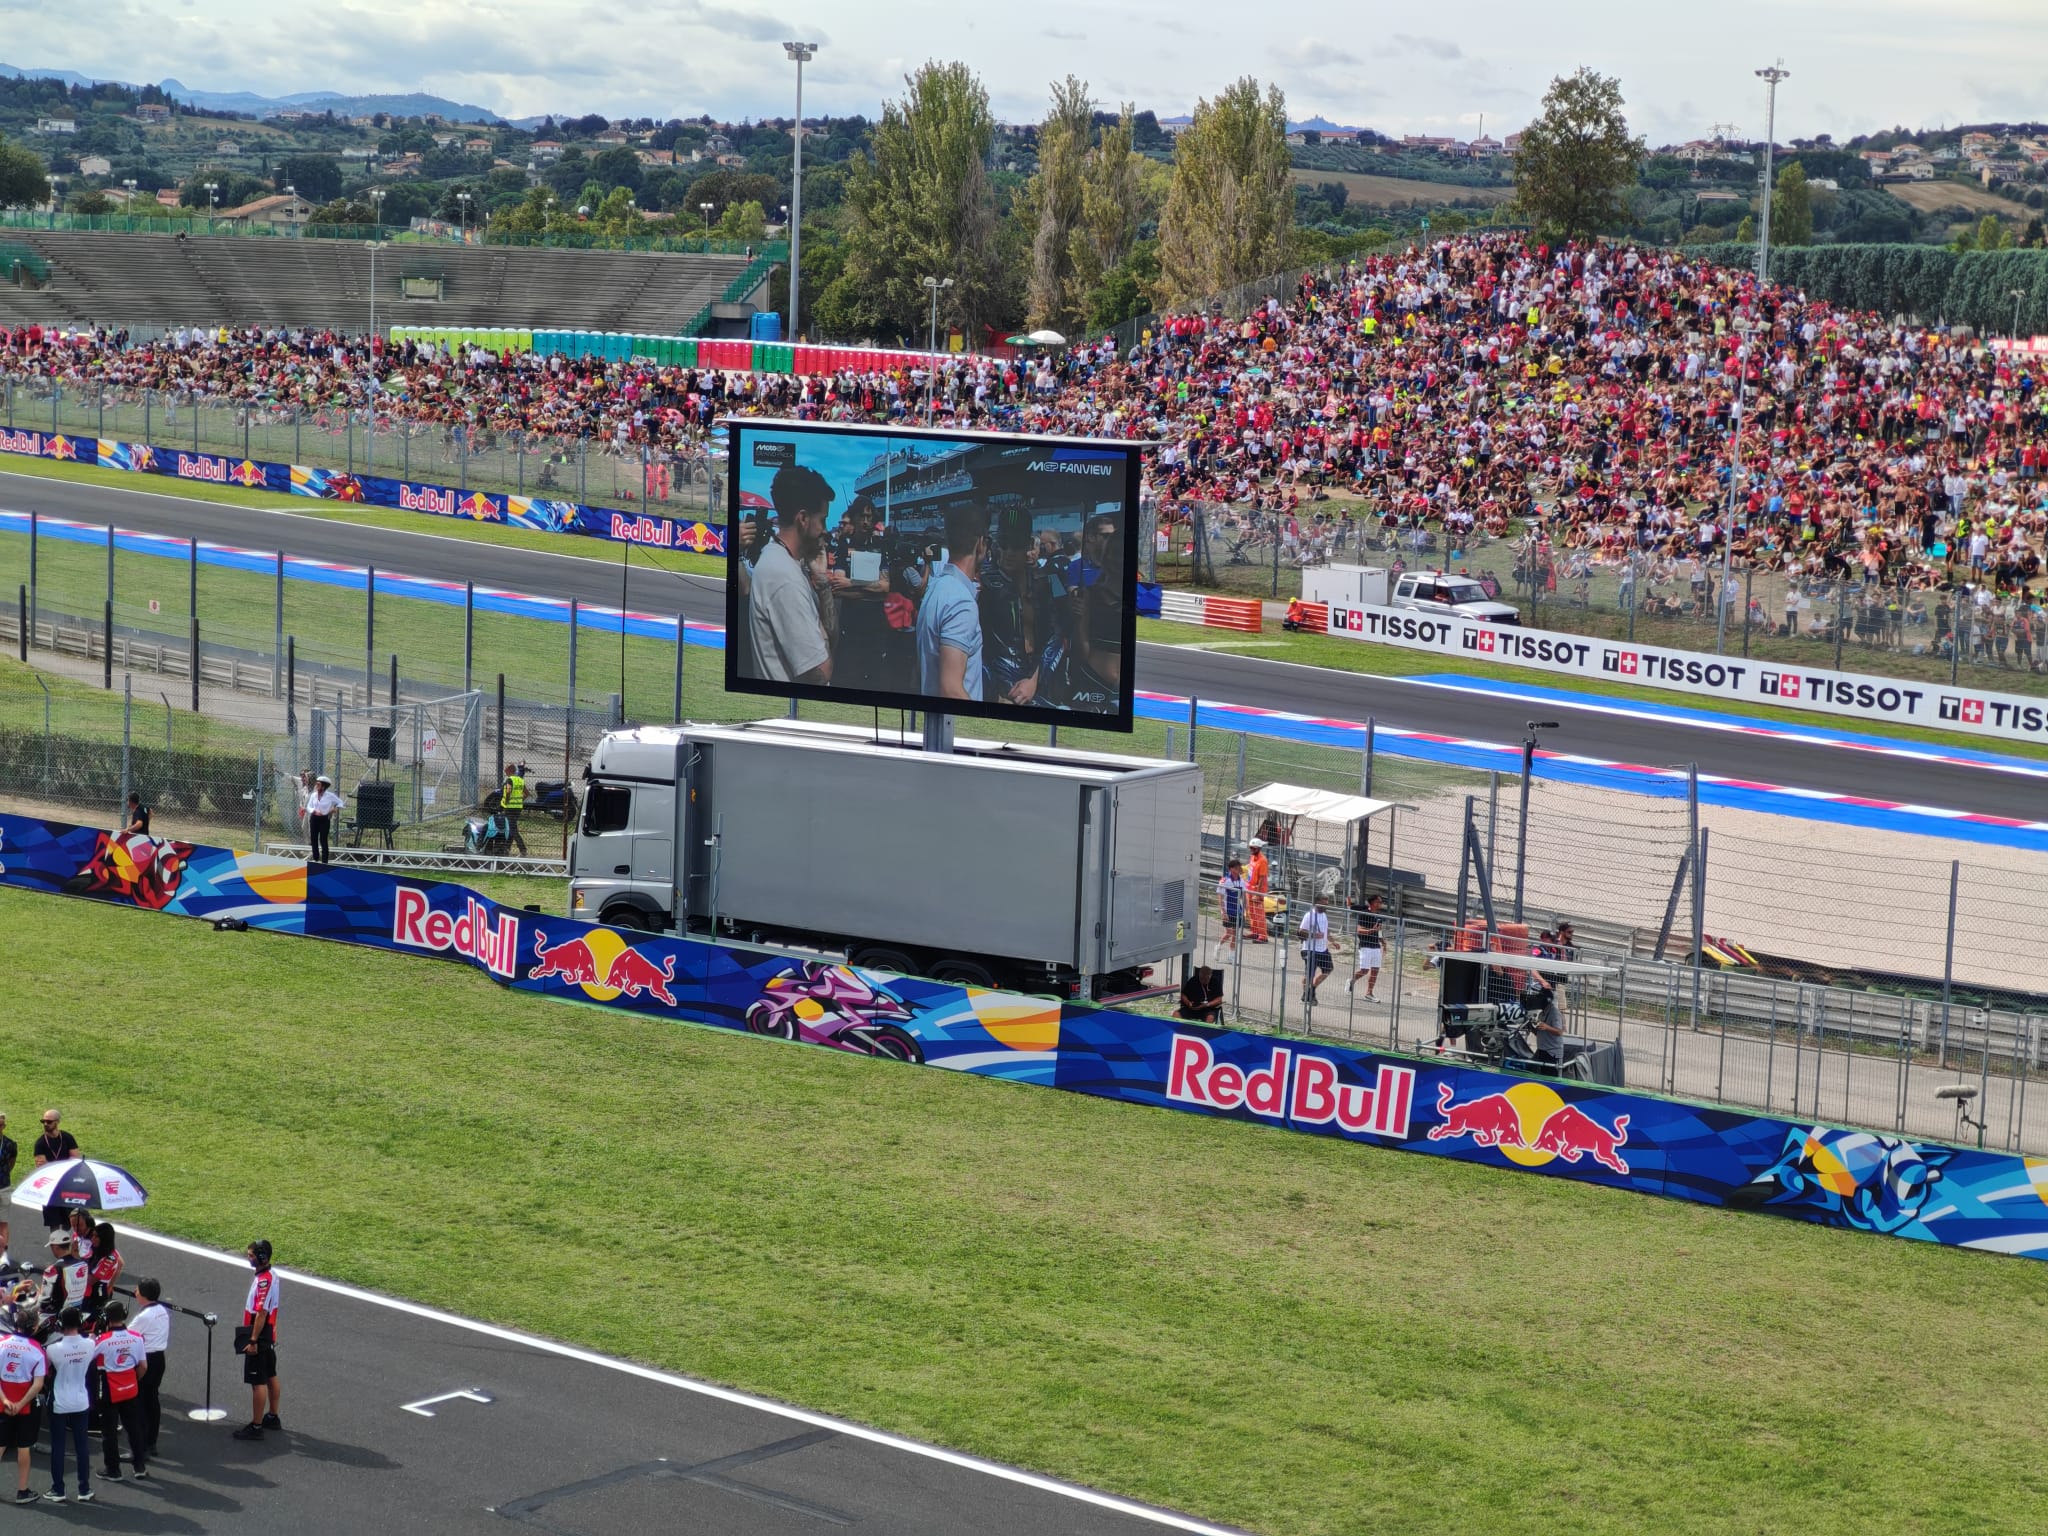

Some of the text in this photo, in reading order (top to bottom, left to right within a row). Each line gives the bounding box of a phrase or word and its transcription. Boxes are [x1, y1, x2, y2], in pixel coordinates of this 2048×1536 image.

[0, 430, 40, 454] Red Bull
[178, 454, 226, 481] Red Bull
[1060, 463, 1112, 476] FANVIEW
[400, 484, 454, 514] Red Bull
[611, 514, 672, 546] Red Bull
[1366, 612, 1451, 645] TISSOT
[1499, 632, 1590, 666] TISSOT
[1642, 654, 1746, 689] TISSOT
[1806, 677, 1923, 714] TISSOT
[1990, 702, 2048, 732] TIS
[393, 885, 519, 978] Red Bull
[1166, 1033, 1416, 1139] Red Bull
